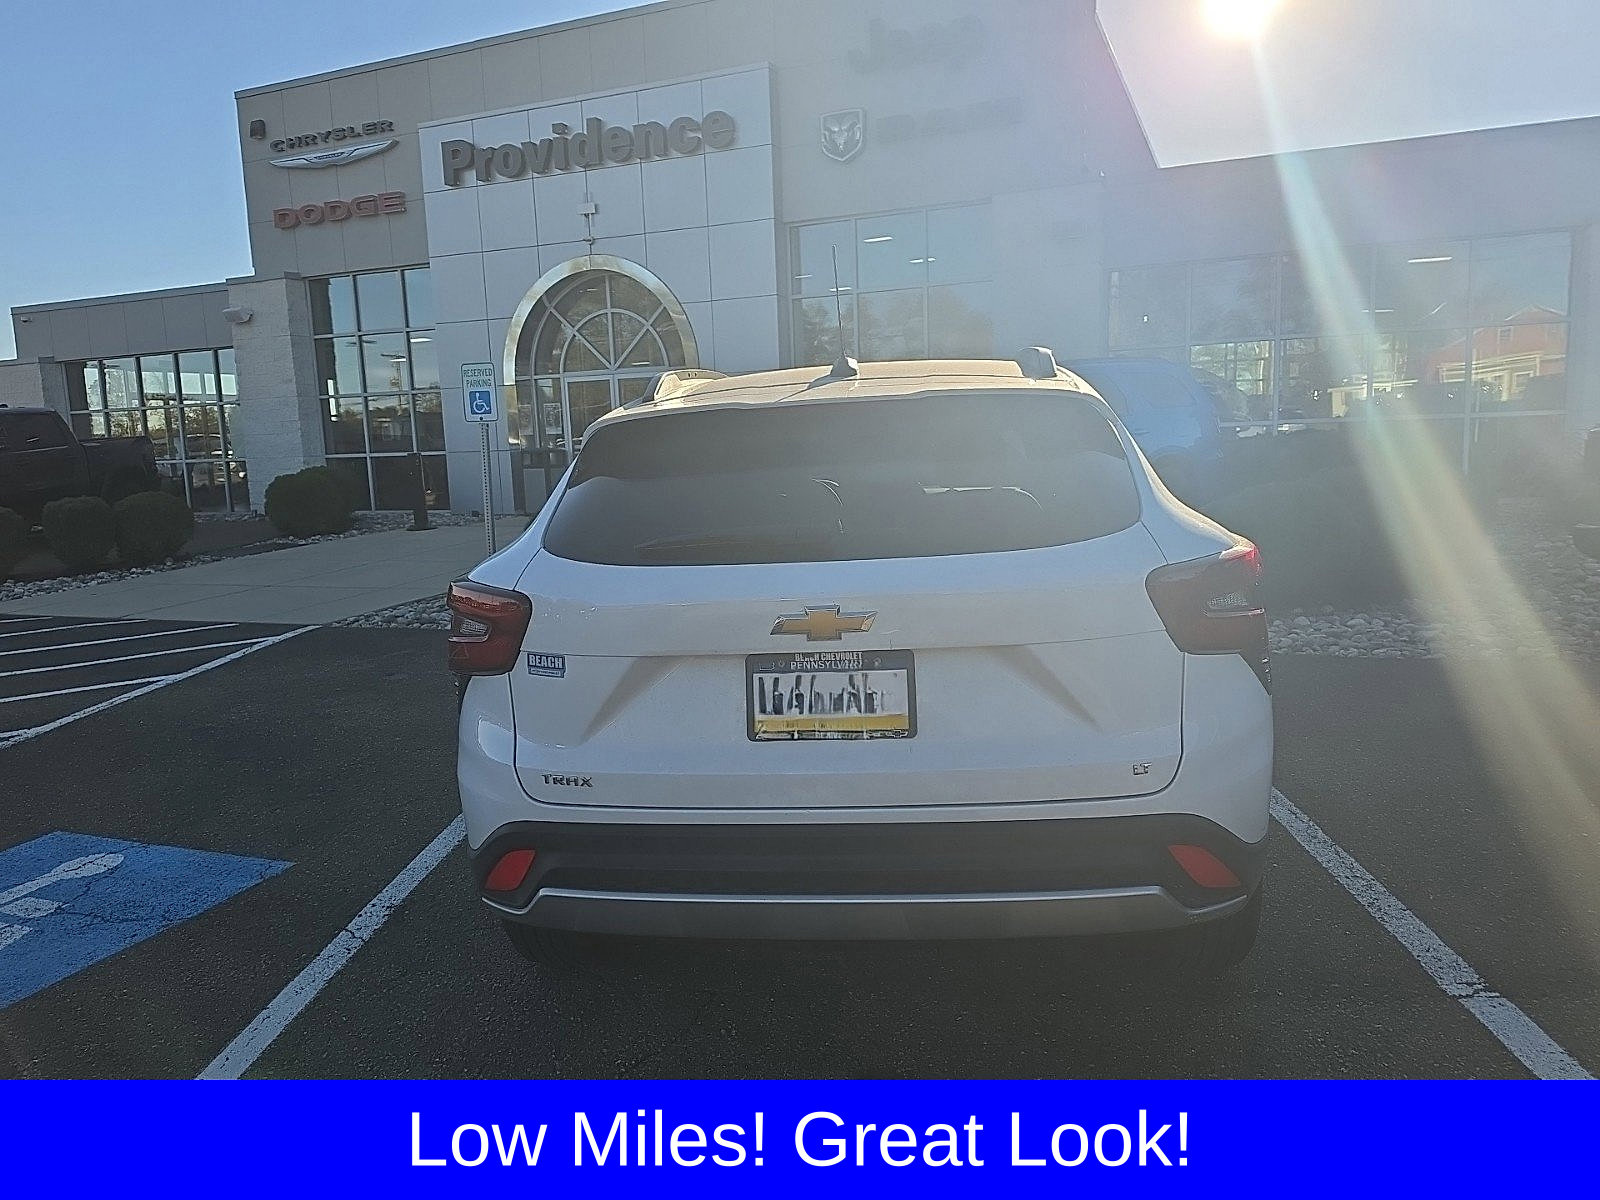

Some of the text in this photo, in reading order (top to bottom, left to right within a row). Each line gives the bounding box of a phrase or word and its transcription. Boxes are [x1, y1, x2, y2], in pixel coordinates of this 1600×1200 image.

[269, 119, 394, 152] CHRYSLER
[441, 110, 737, 187] Providence
[273, 190, 405, 229] DODGE
[463, 368, 493, 378] RESERVED
[466, 378, 492, 388] PARKING
[528, 654, 563, 669] BEACH
[821, 652, 863, 661] CHEVROLET
[1132, 762, 1152, 776] LT
[541, 773, 593, 788] TRAX
